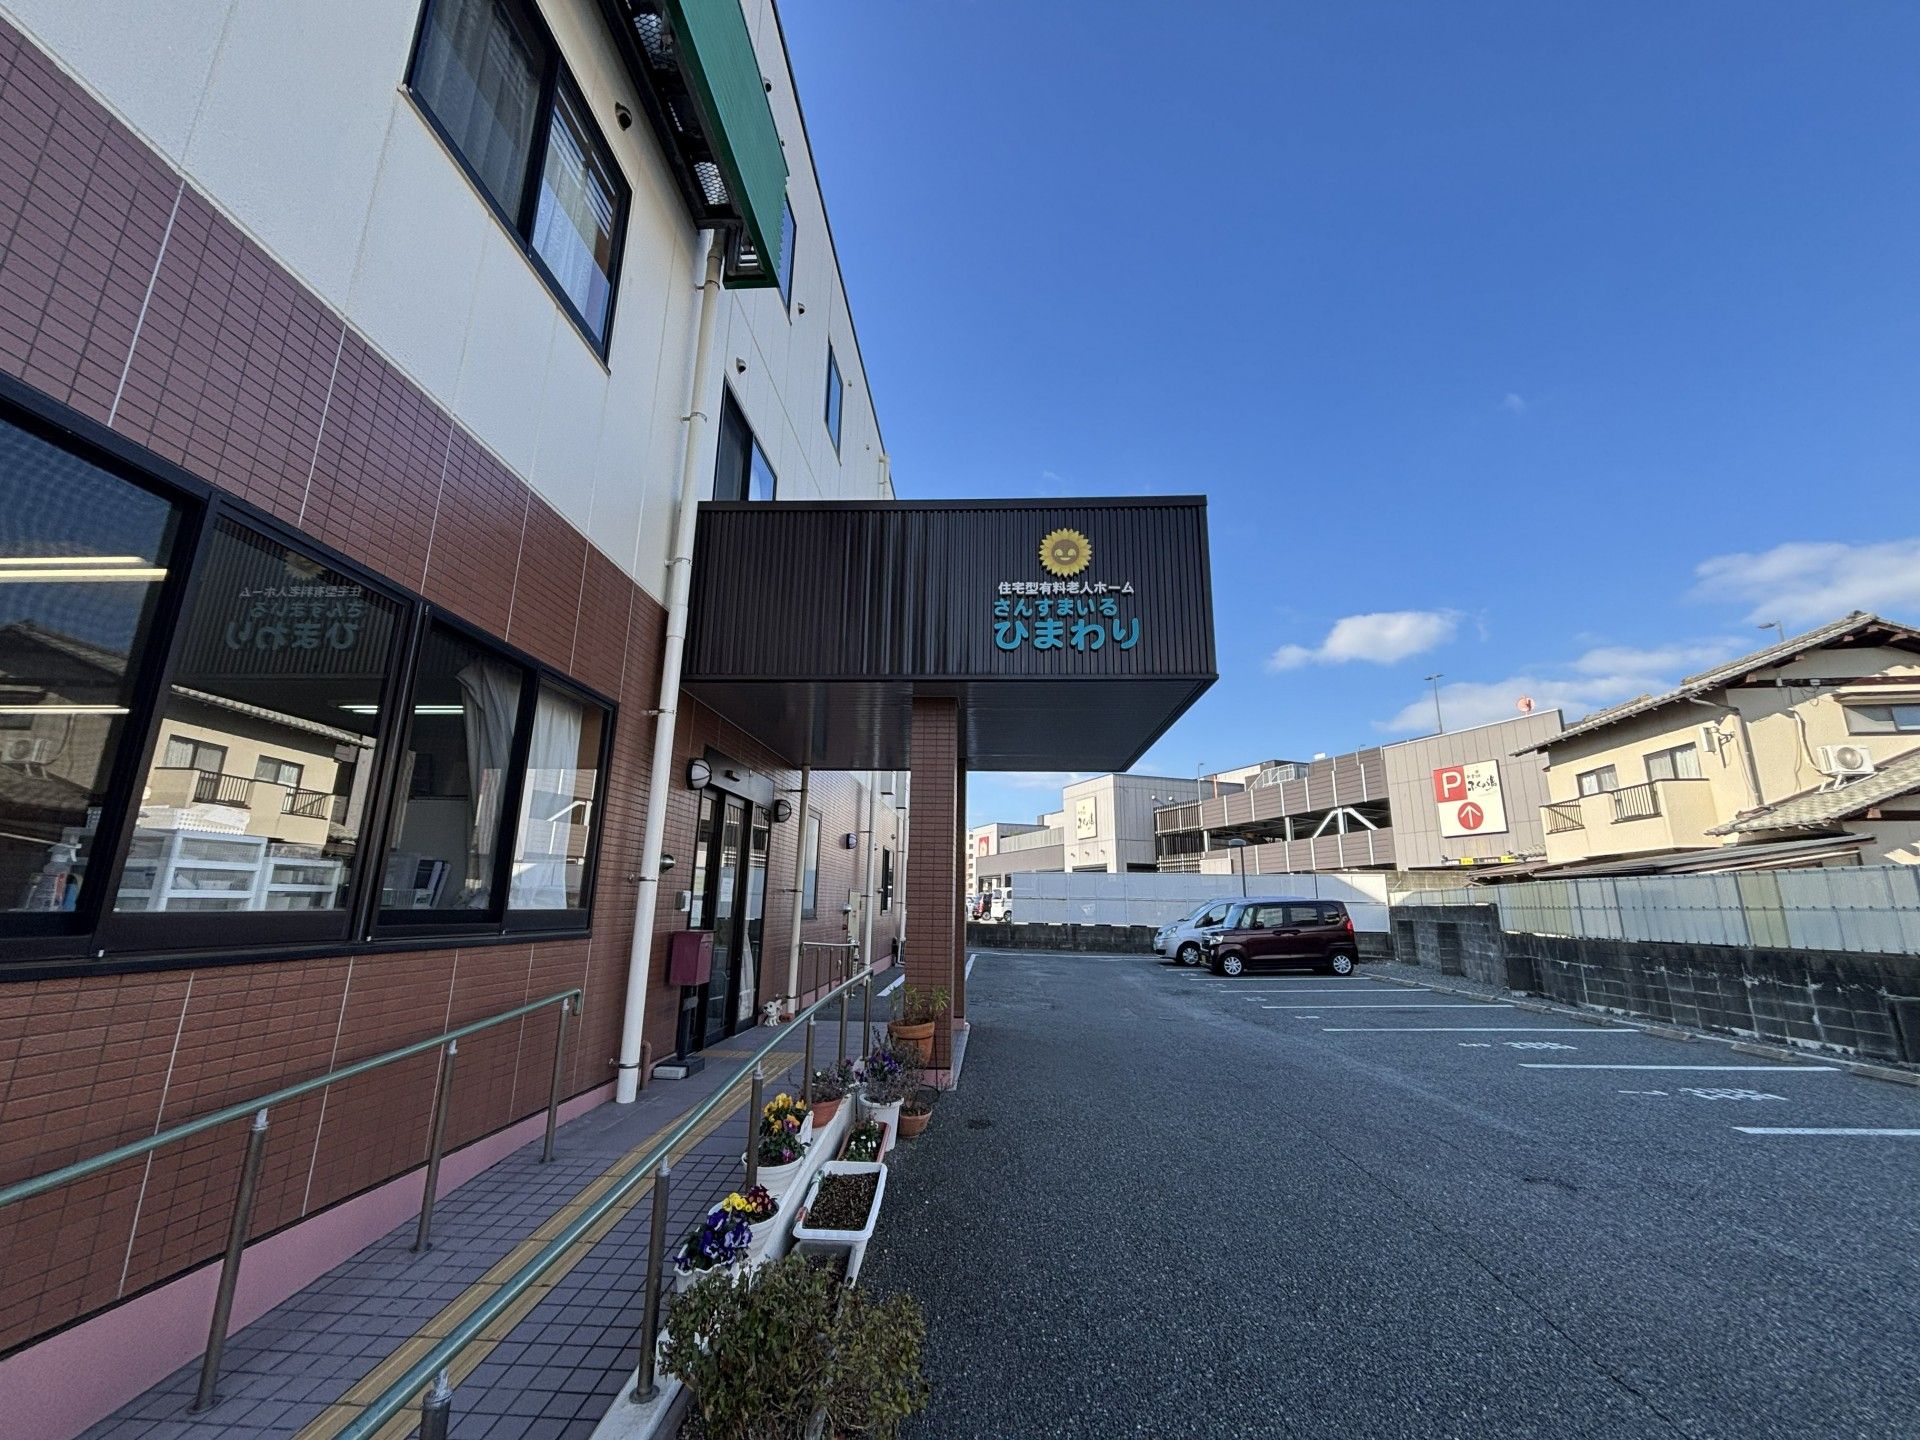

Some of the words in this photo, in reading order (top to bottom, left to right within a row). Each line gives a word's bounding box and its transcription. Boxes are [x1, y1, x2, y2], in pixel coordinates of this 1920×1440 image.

[998, 582, 1135, 595] 住宅型有料老人ホーム
[994, 598, 1118, 617] さんすまいる
[994, 618, 1140, 651] ひまわり
[1441, 771, 1462, 798] P
